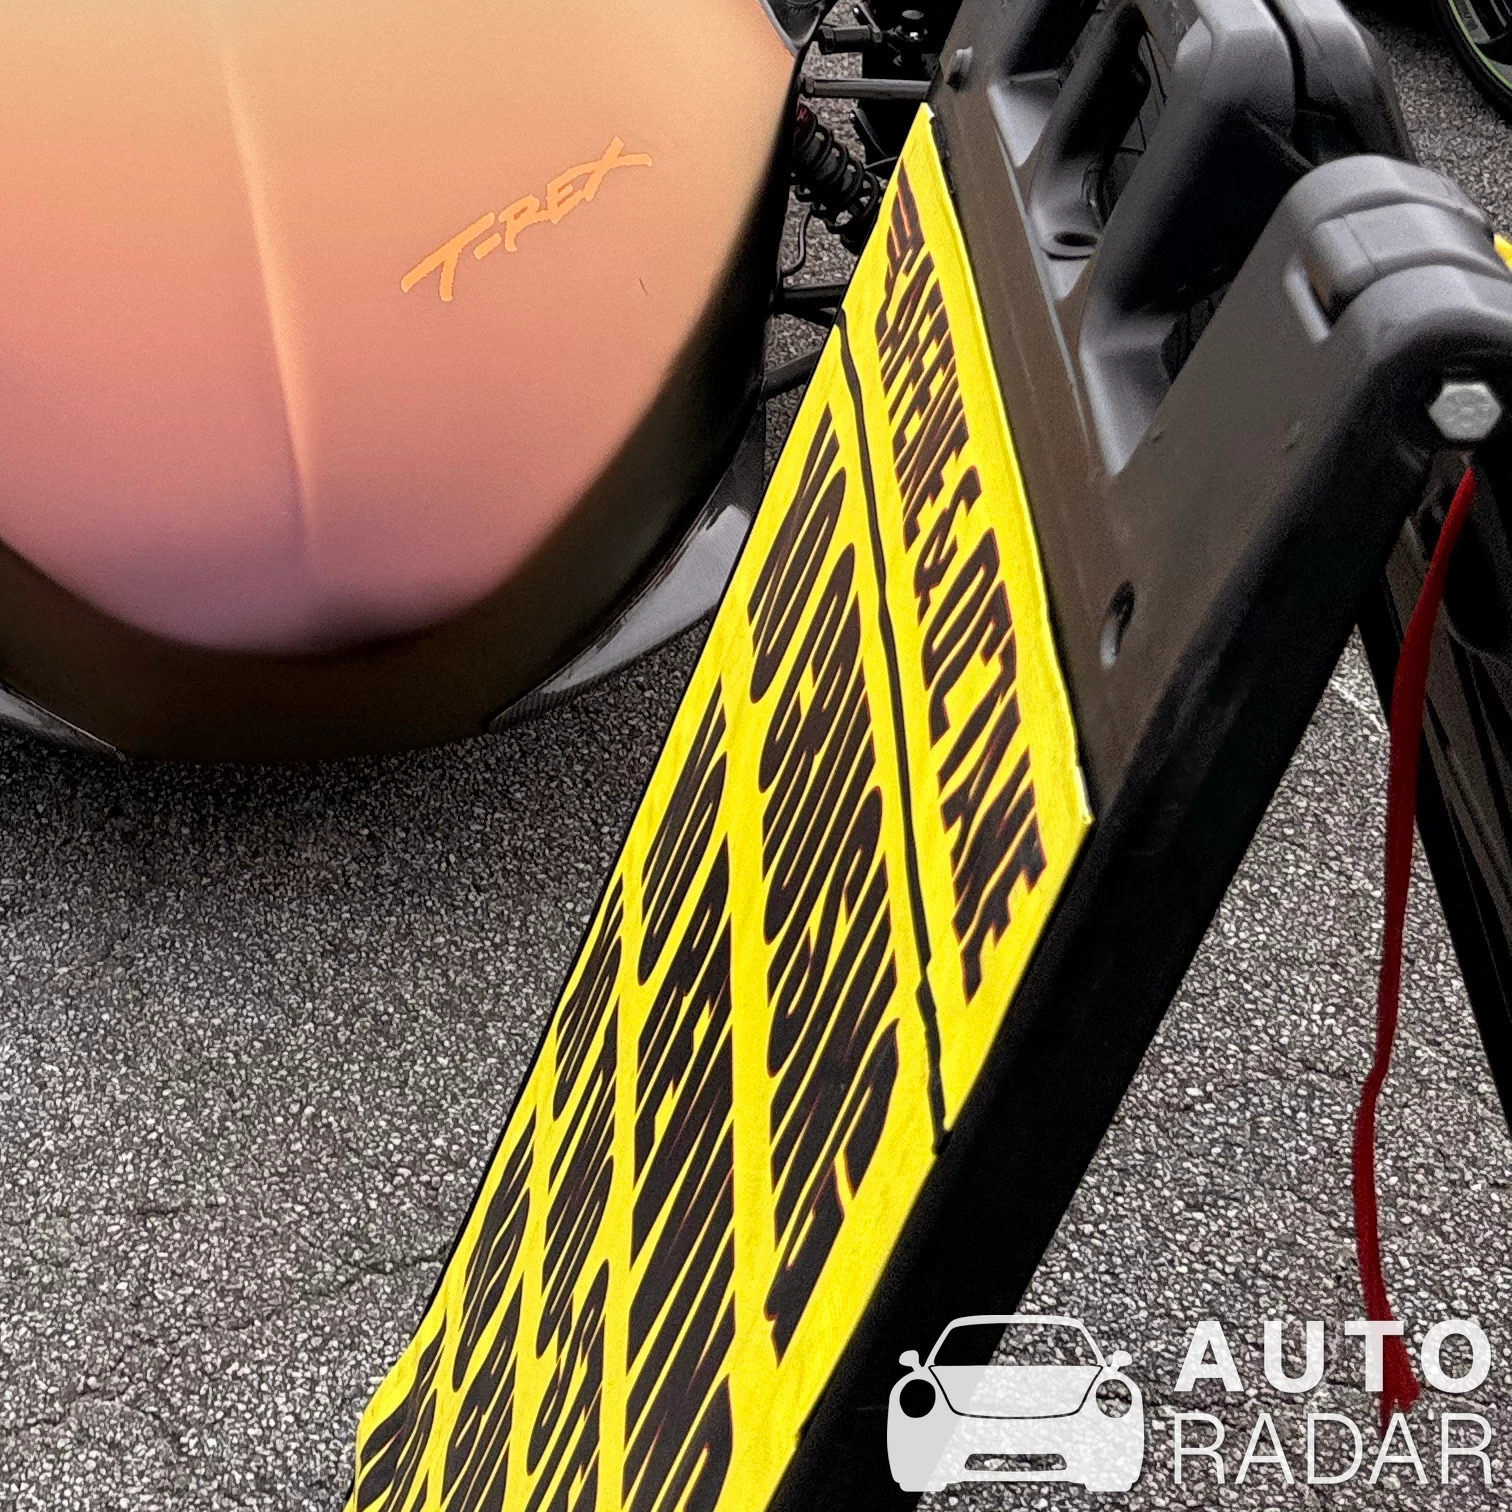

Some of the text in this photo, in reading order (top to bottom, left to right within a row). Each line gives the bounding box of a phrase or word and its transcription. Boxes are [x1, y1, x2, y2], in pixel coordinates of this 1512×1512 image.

[400, 136, 653, 303] T-REX
[875, 163, 1046, 1002] CAFFEINE & OCTANE
[637, 677, 727, 986] NO
[747, 404, 899, 1363] NO CRUISING
[451, 1100, 537, 1393] NO
[524, 874, 624, 1512] NO TWO-STE
